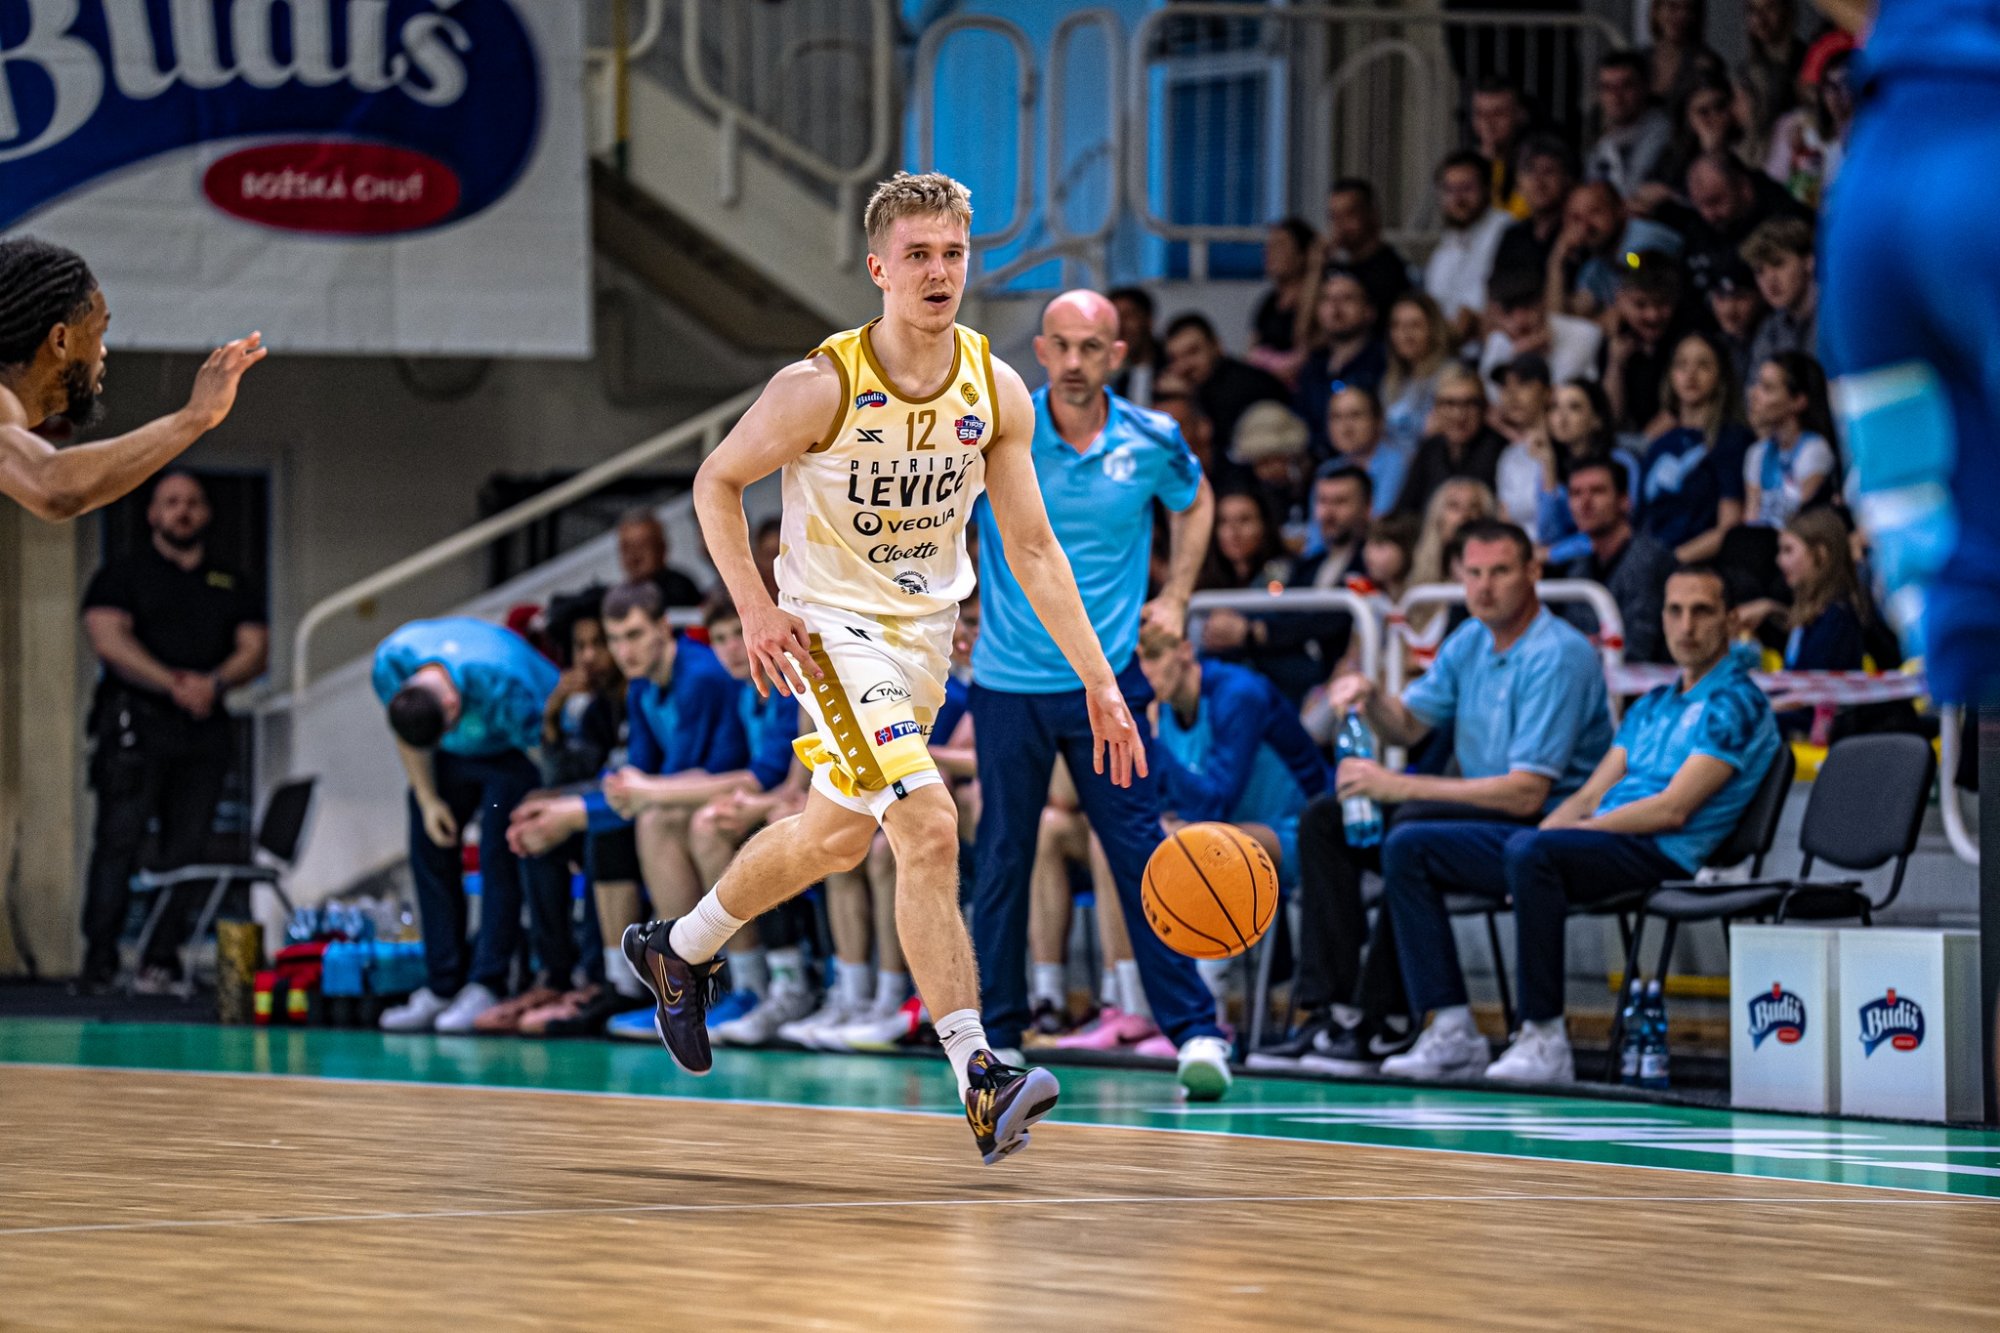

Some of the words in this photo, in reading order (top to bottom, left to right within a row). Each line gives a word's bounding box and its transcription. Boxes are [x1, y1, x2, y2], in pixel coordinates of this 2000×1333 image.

[906, 409, 936, 451] 12
[850, 453, 974, 475] PATRIOT
[887, 508, 955, 533] VEOLIA
[1864, 1000, 1919, 1039] Budiš
